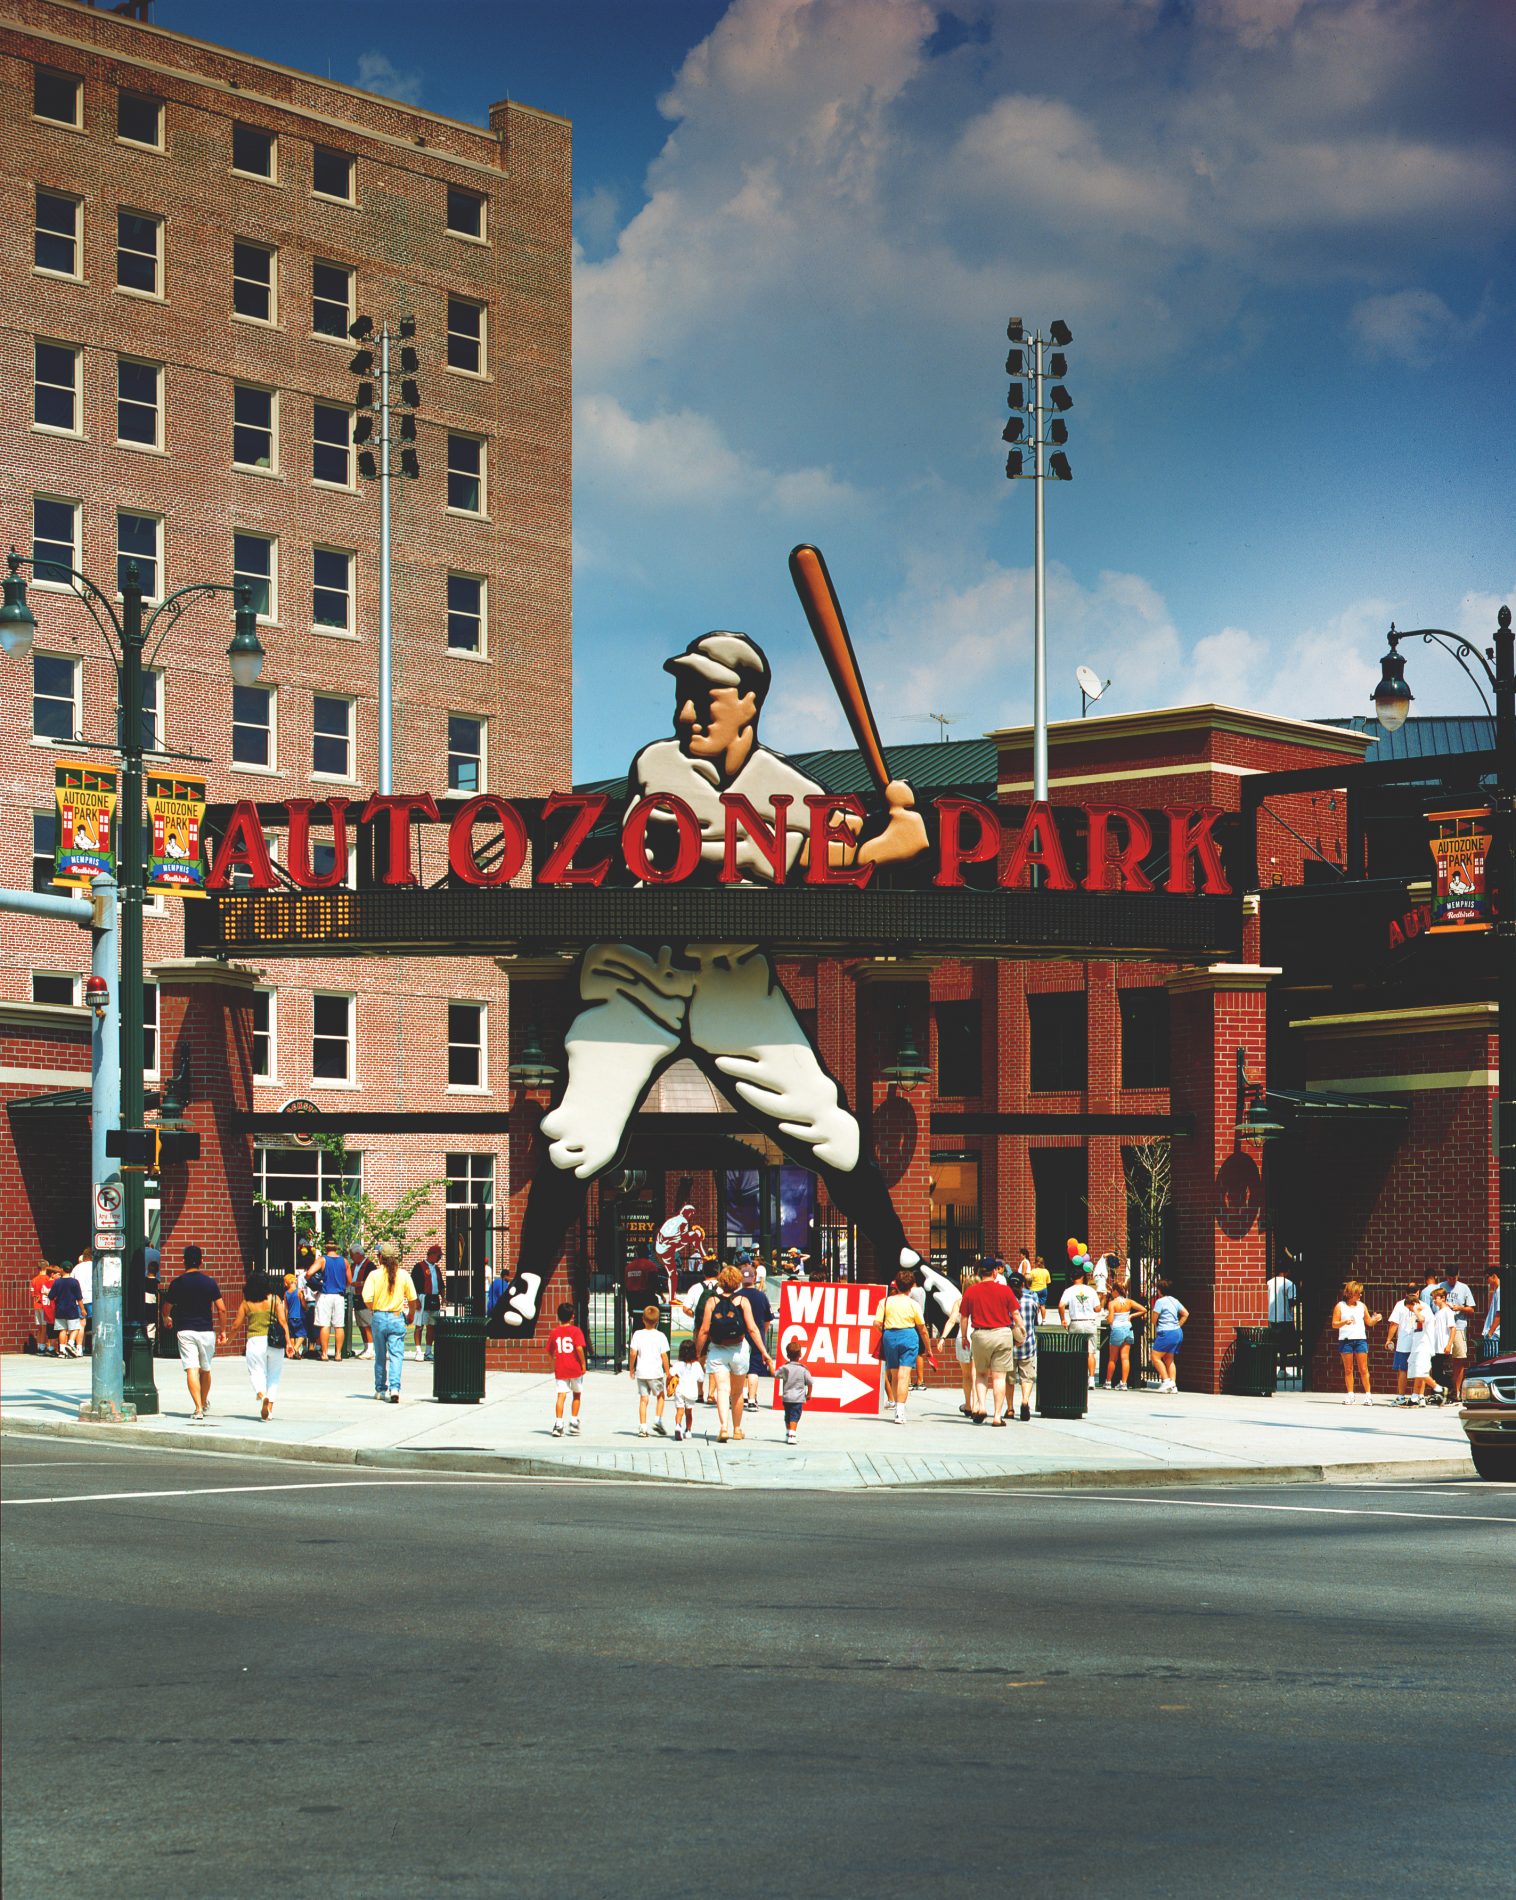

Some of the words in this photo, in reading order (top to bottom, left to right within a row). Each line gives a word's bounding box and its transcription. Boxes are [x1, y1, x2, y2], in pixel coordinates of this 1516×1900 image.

[63, 791, 109, 809] AUTOZONE
[74, 807, 98, 821] PARK
[155, 801, 198, 817] AUTOZONE
[165, 816, 188, 830] PARK
[204, 790, 877, 890] AUTOZONE
[932, 797, 1232, 896] PARK
[1438, 838, 1484, 854] AUTOZONE
[71, 856, 99, 866] MEMPHIS
[1449, 853, 1473, 867] PARK
[71, 866, 99, 875] Redbirds
[162, 864, 189, 874] MEMPHIS
[163, 874, 189, 883] Redbirds
[1446, 900, 1475, 909] MEMPHIS
[1447, 910, 1475, 919] Redbirds
[787, 1285, 876, 1325] WILL
[555, 1336, 574, 1354] 16
[781, 1325, 880, 1364] CALL
